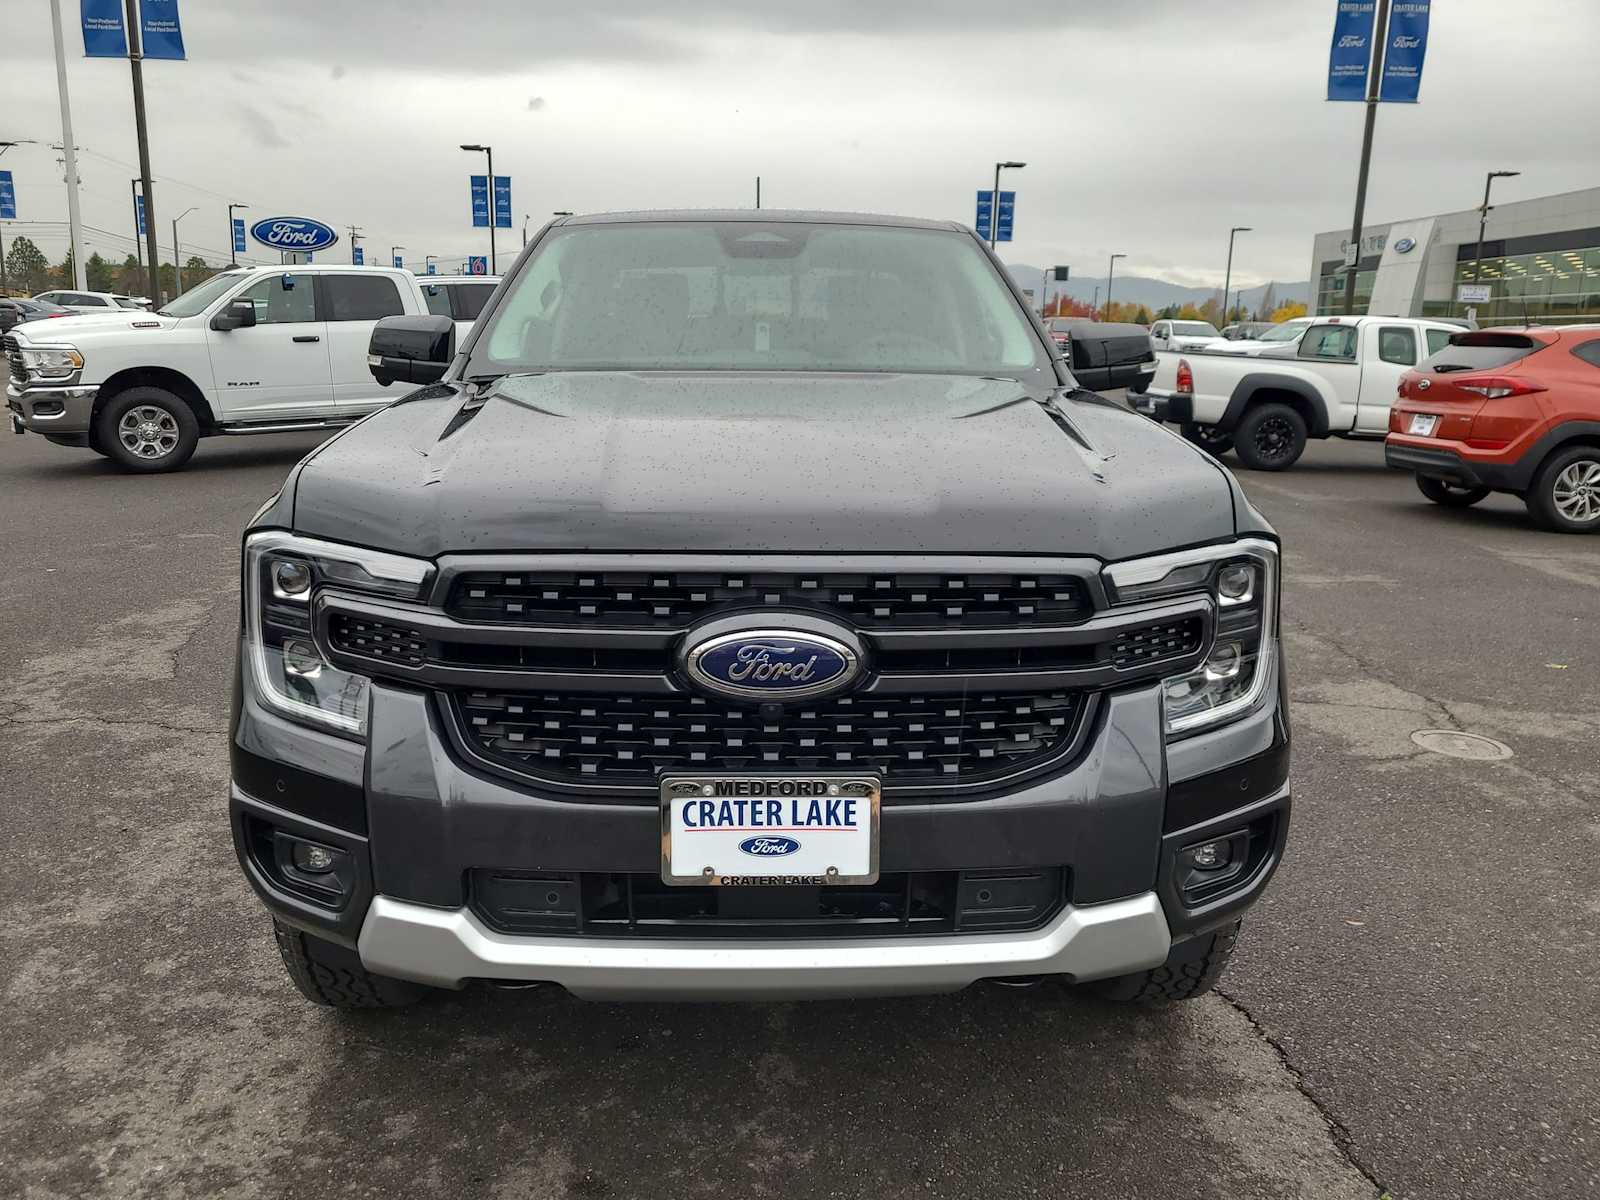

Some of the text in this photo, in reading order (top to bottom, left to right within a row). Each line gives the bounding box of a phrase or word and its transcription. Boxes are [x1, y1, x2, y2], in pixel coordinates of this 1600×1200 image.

[1338, 35, 1366, 48] Ford
[1393, 35, 1420, 48] Ford
[268, 221, 318, 245] Ford
[471, 257, 485, 275] 6
[728, 644, 818, 681] Ford
[715, 780, 828, 796] MEDFORD
[682, 799, 857, 827] CRATER LAKE
[750, 838, 789, 854] Ford
[720, 875, 822, 886] CRATER LAKE
